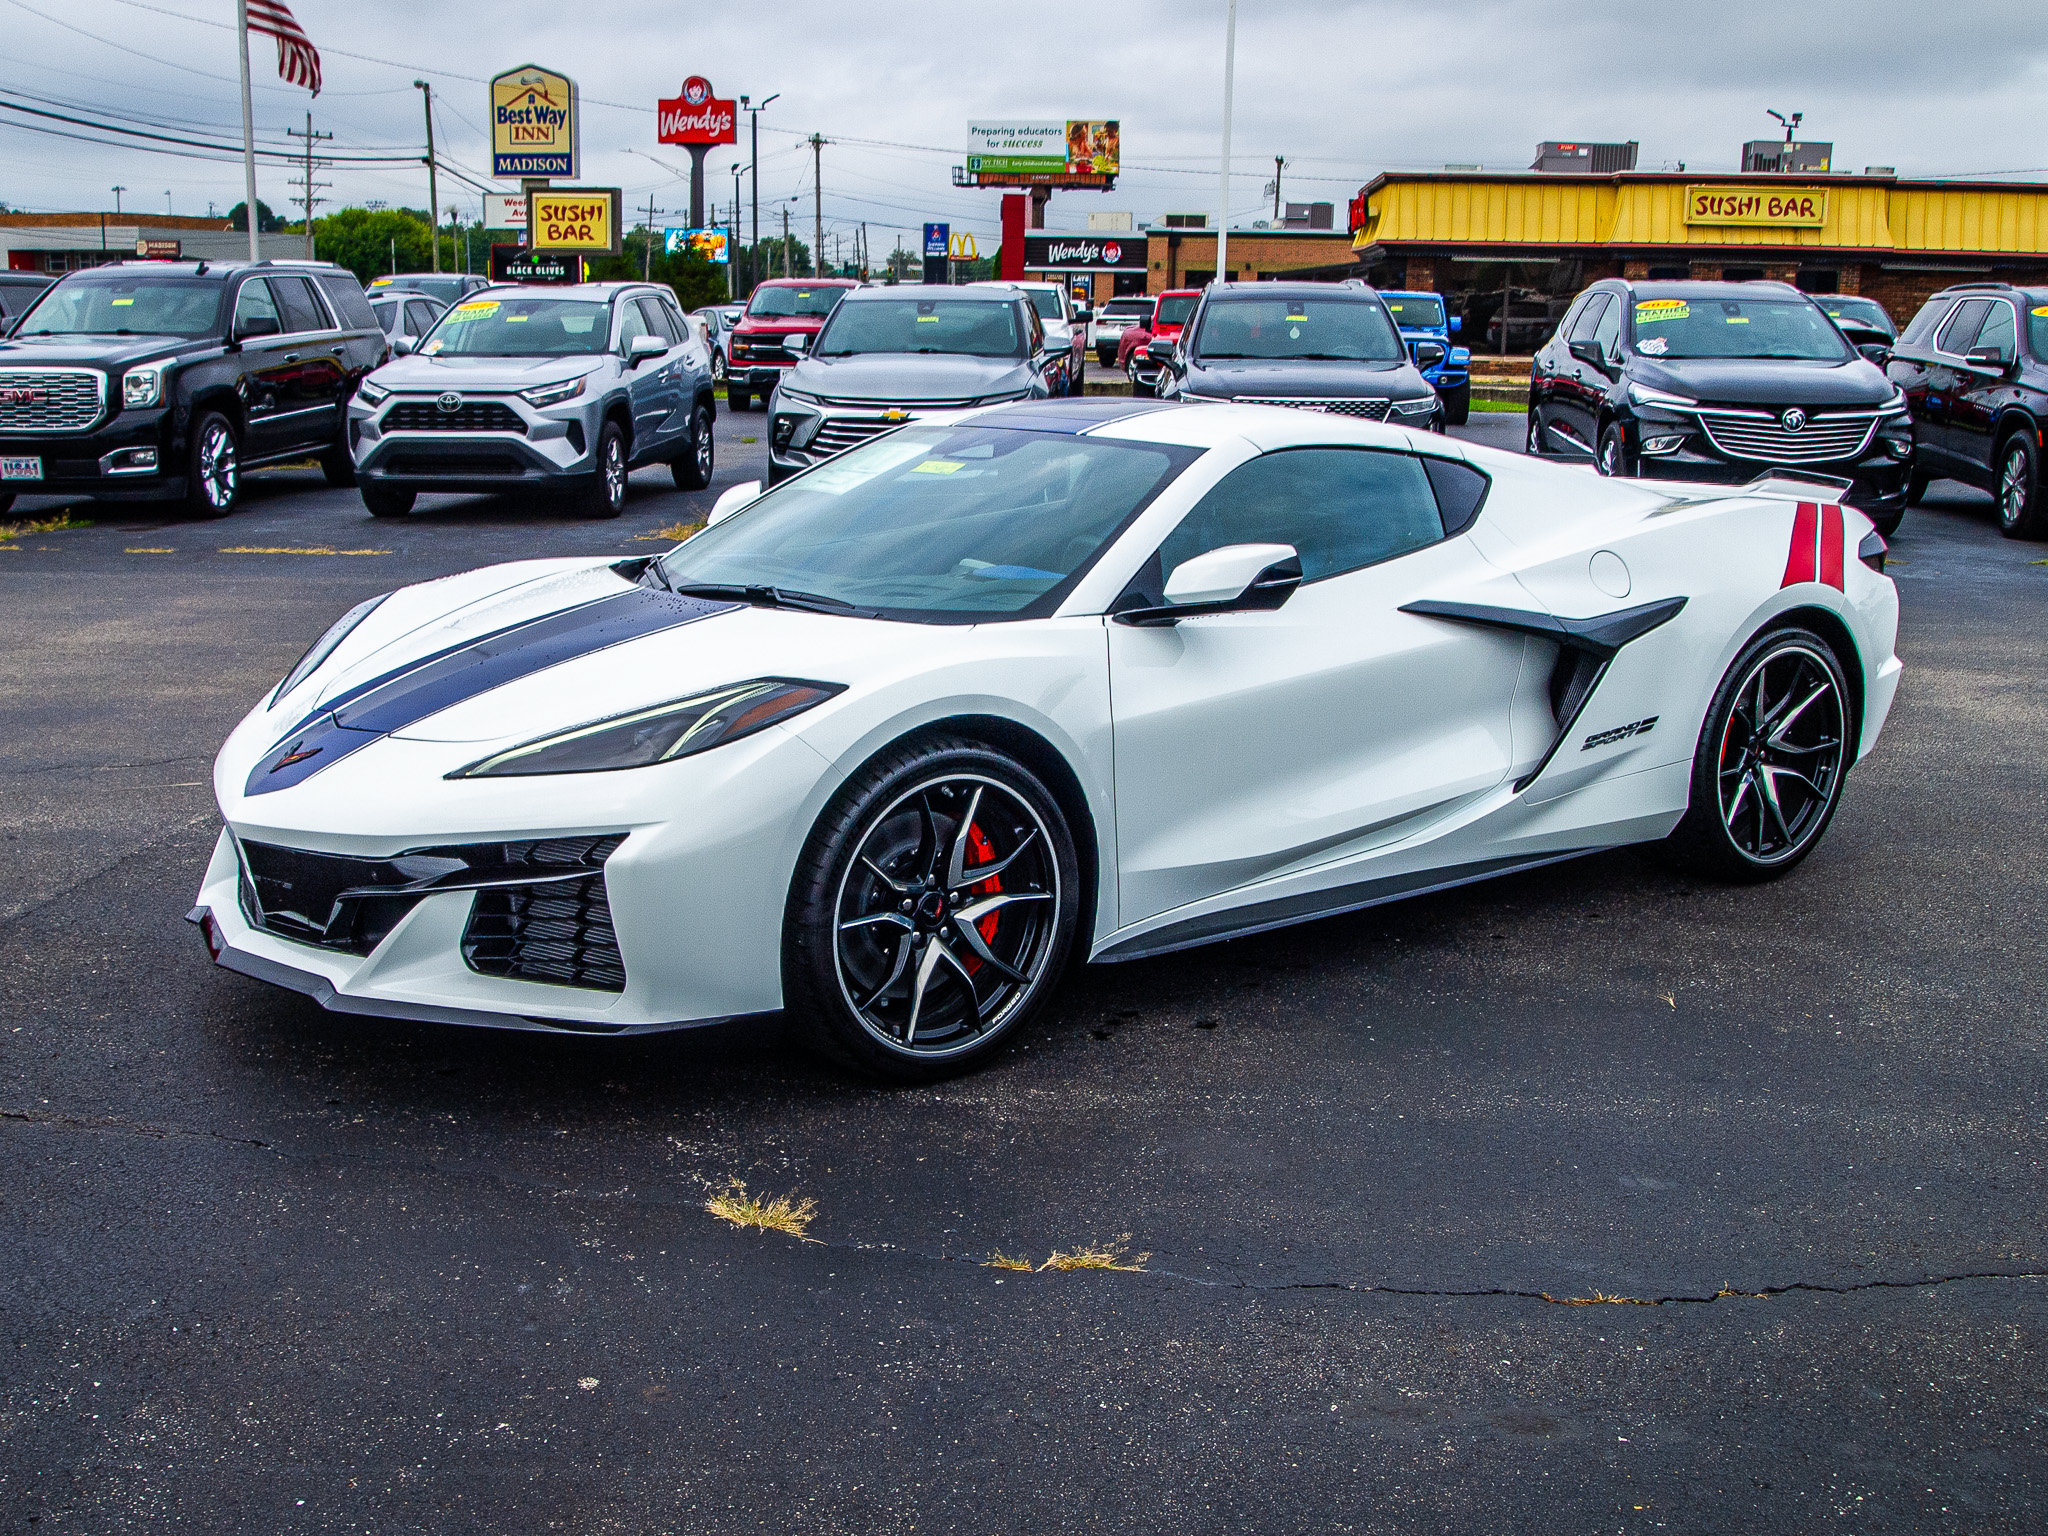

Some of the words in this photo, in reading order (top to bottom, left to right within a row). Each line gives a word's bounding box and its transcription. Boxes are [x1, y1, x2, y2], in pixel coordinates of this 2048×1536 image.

[660, 105, 732, 138] Wendy's
[514, 126, 550, 140] INN
[971, 126, 1016, 138] Preparing
[1017, 125, 1063, 136] educators
[986, 138, 1000, 149] for
[1001, 139, 1044, 149] success
[498, 157, 568, 172] MADISON
[540, 204, 603, 222] SUSHI
[1694, 195, 1761, 217] SUSHI
[1767, 196, 1816, 218] BAR
[547, 223, 595, 241] BAR
[1048, 240, 1100, 264] Wendy's
[506, 265, 532, 275] BLACK
[534, 265, 565, 276] OLIVES
[3, 462, 39, 476] USA1
[1584, 721, 1641, 743] GRAND
